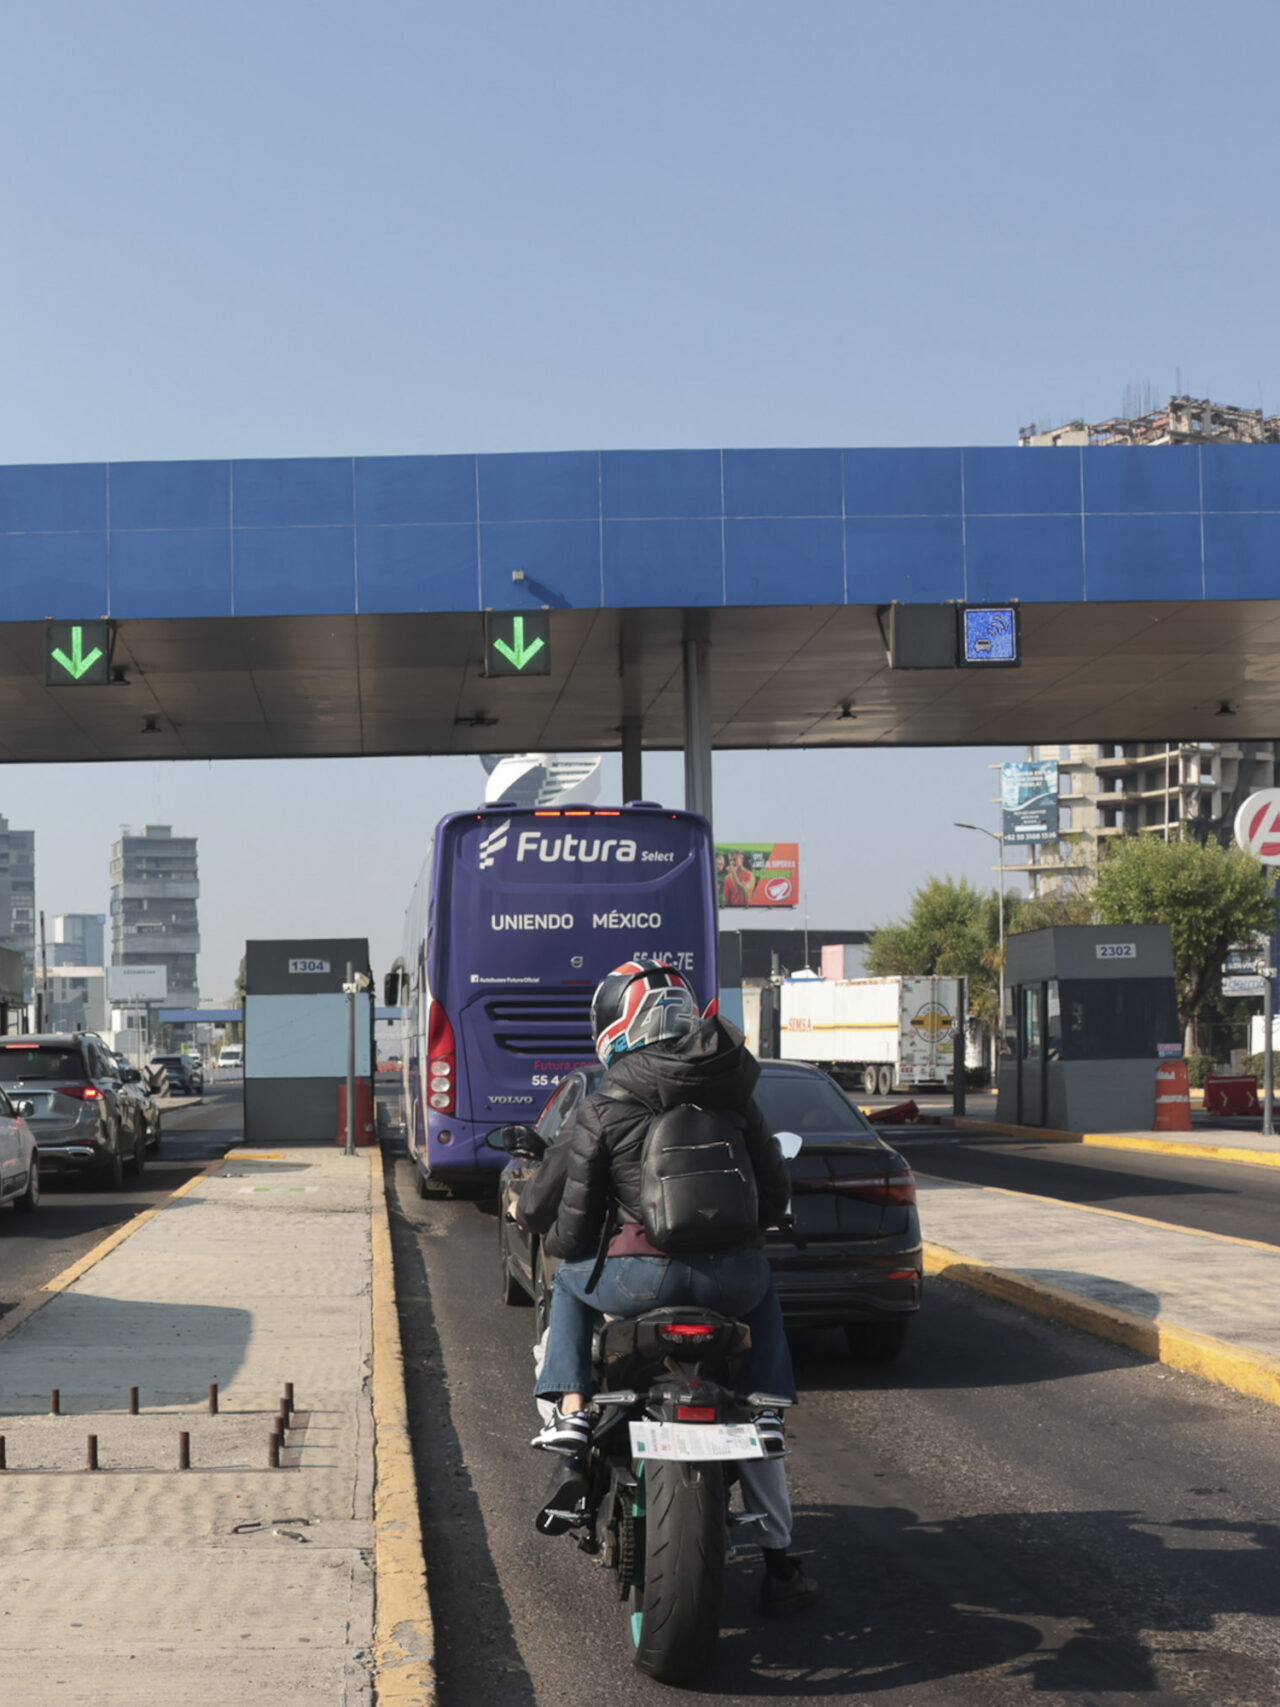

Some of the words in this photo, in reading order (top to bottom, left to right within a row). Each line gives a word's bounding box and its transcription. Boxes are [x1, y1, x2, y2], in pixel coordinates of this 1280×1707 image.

[516, 831, 637, 862] Futura
[640, 851, 674, 862] Select
[491, 914, 574, 931] UNIENDO
[592, 910, 662, 929] MÉXICO
[1100, 946, 1131, 957] 2302
[291, 961, 325, 971] 1304
[531, 1075, 549, 1086] 55
[488, 1096, 533, 1104] VOLVO
